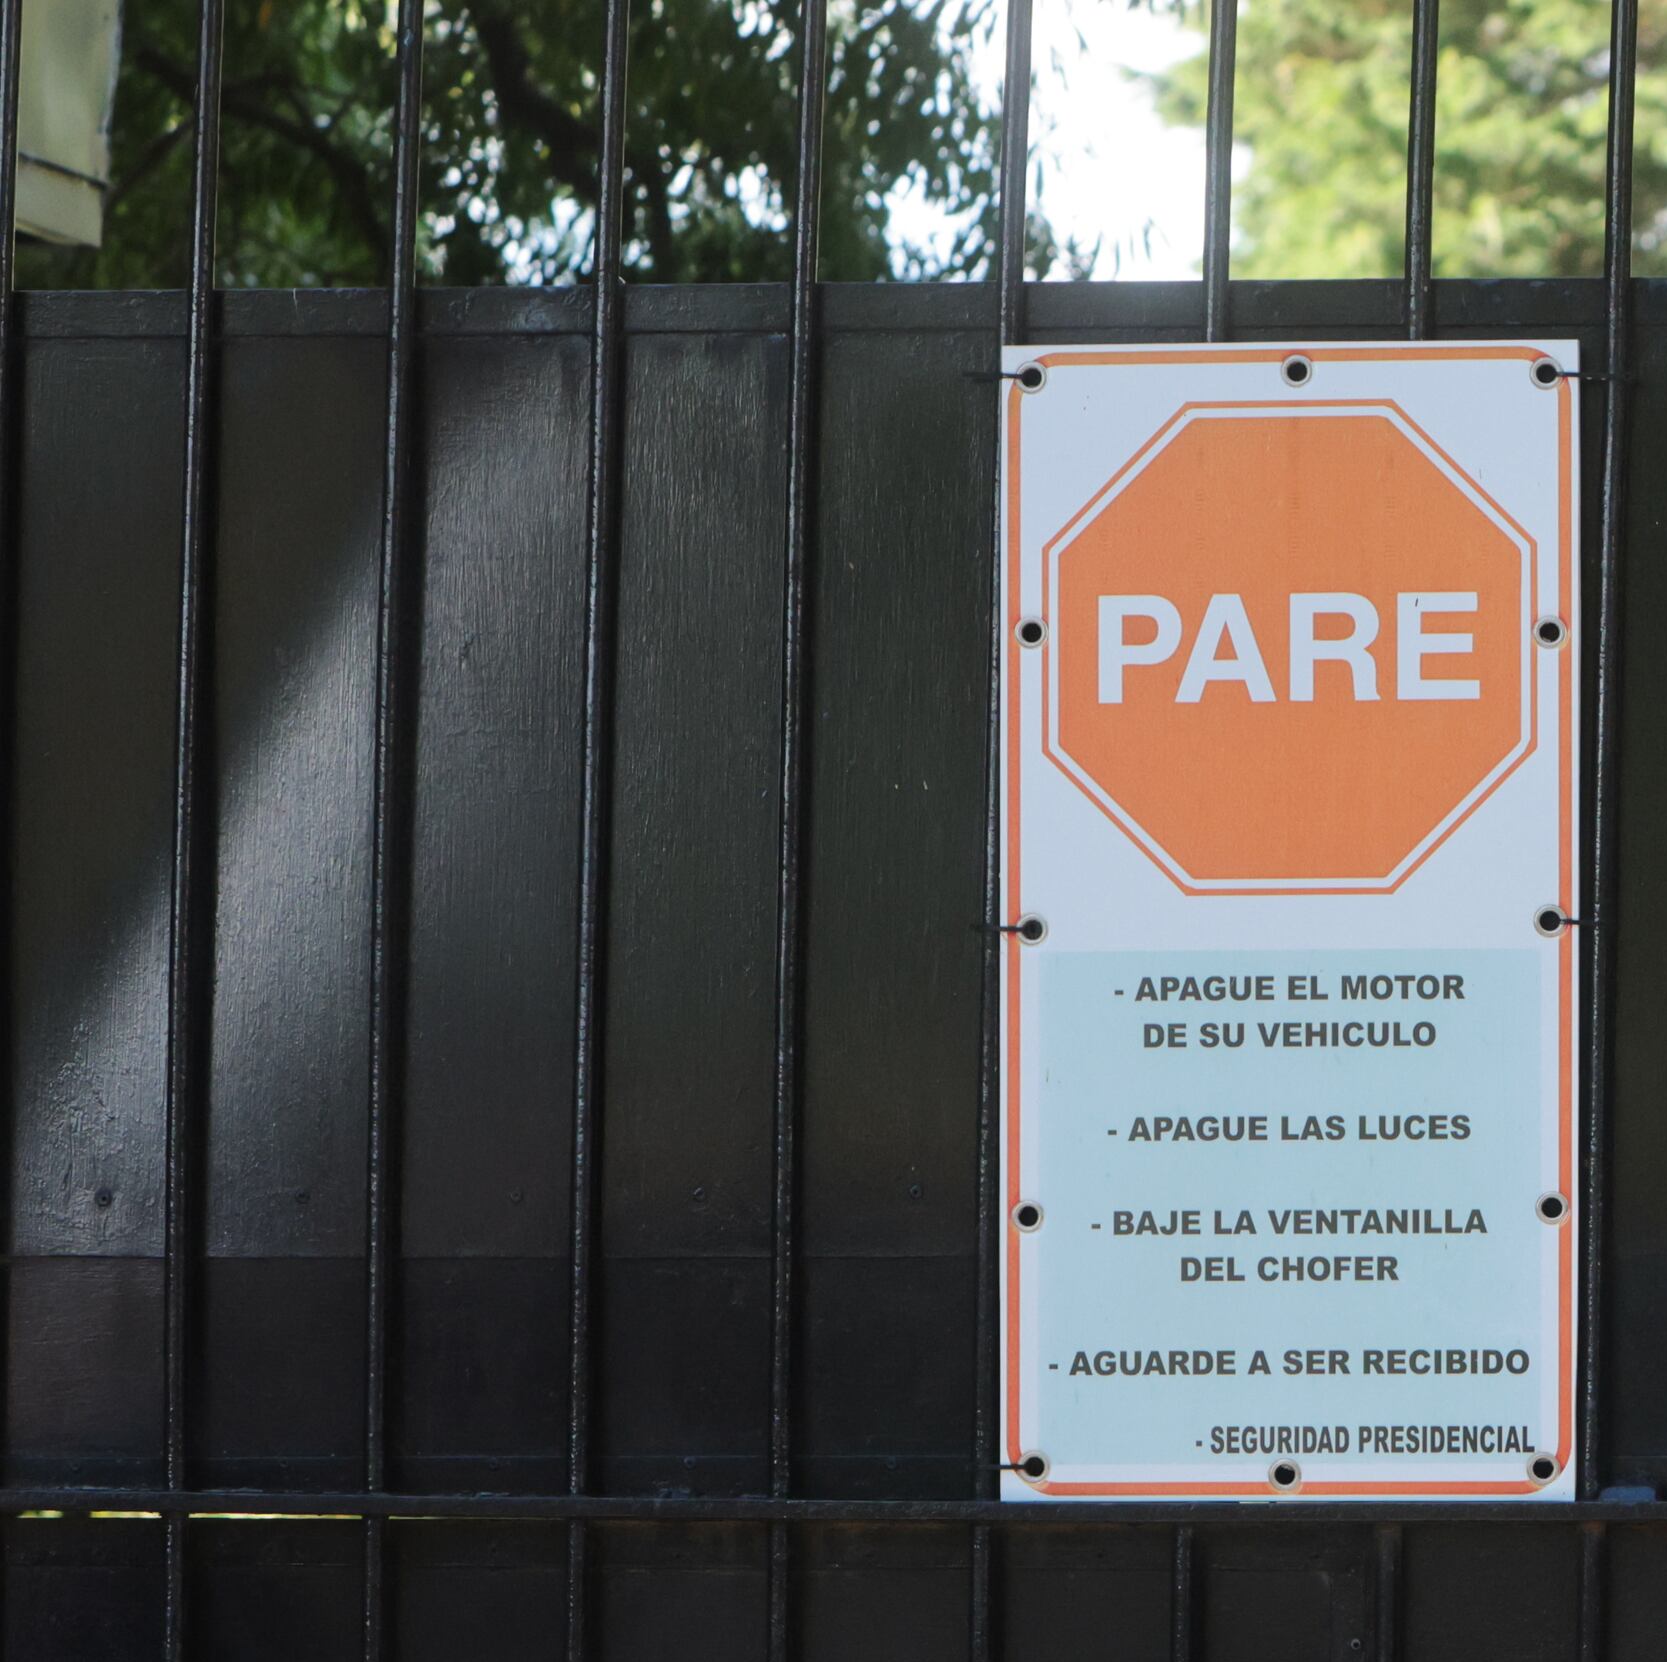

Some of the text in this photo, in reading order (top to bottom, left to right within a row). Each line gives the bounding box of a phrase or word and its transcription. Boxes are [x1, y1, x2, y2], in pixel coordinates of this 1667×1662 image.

[1098, 592, 1480, 704] PARE
[1135, 975, 1275, 1002] APAGUE
[1287, 975, 1329, 1001] EL
[1341, 974, 1465, 1001] MOTOR
[1143, 1021, 1436, 1048] DE SU VEHICULO
[1128, 1116, 1268, 1142] APAGUE
[1281, 1115, 1346, 1141] LAS
[1358, 1114, 1471, 1141] LUCES
[1113, 1210, 1201, 1236] BAJE
[1214, 1210, 1257, 1235] LA
[1267, 1208, 1488, 1235] VENTANILLA
[1180, 1256, 1399, 1282] DEL CHOFER
[1069, 1350, 1236, 1376] AGUARDE
[1247, 1350, 1272, 1375] A
[1282, 1349, 1351, 1375] SER
[1363, 1349, 1530, 1375] RECIBIDO
[1210, 1425, 1350, 1455] SEGURIDAD
[1358, 1425, 1536, 1454] PRESIDENCIAL
